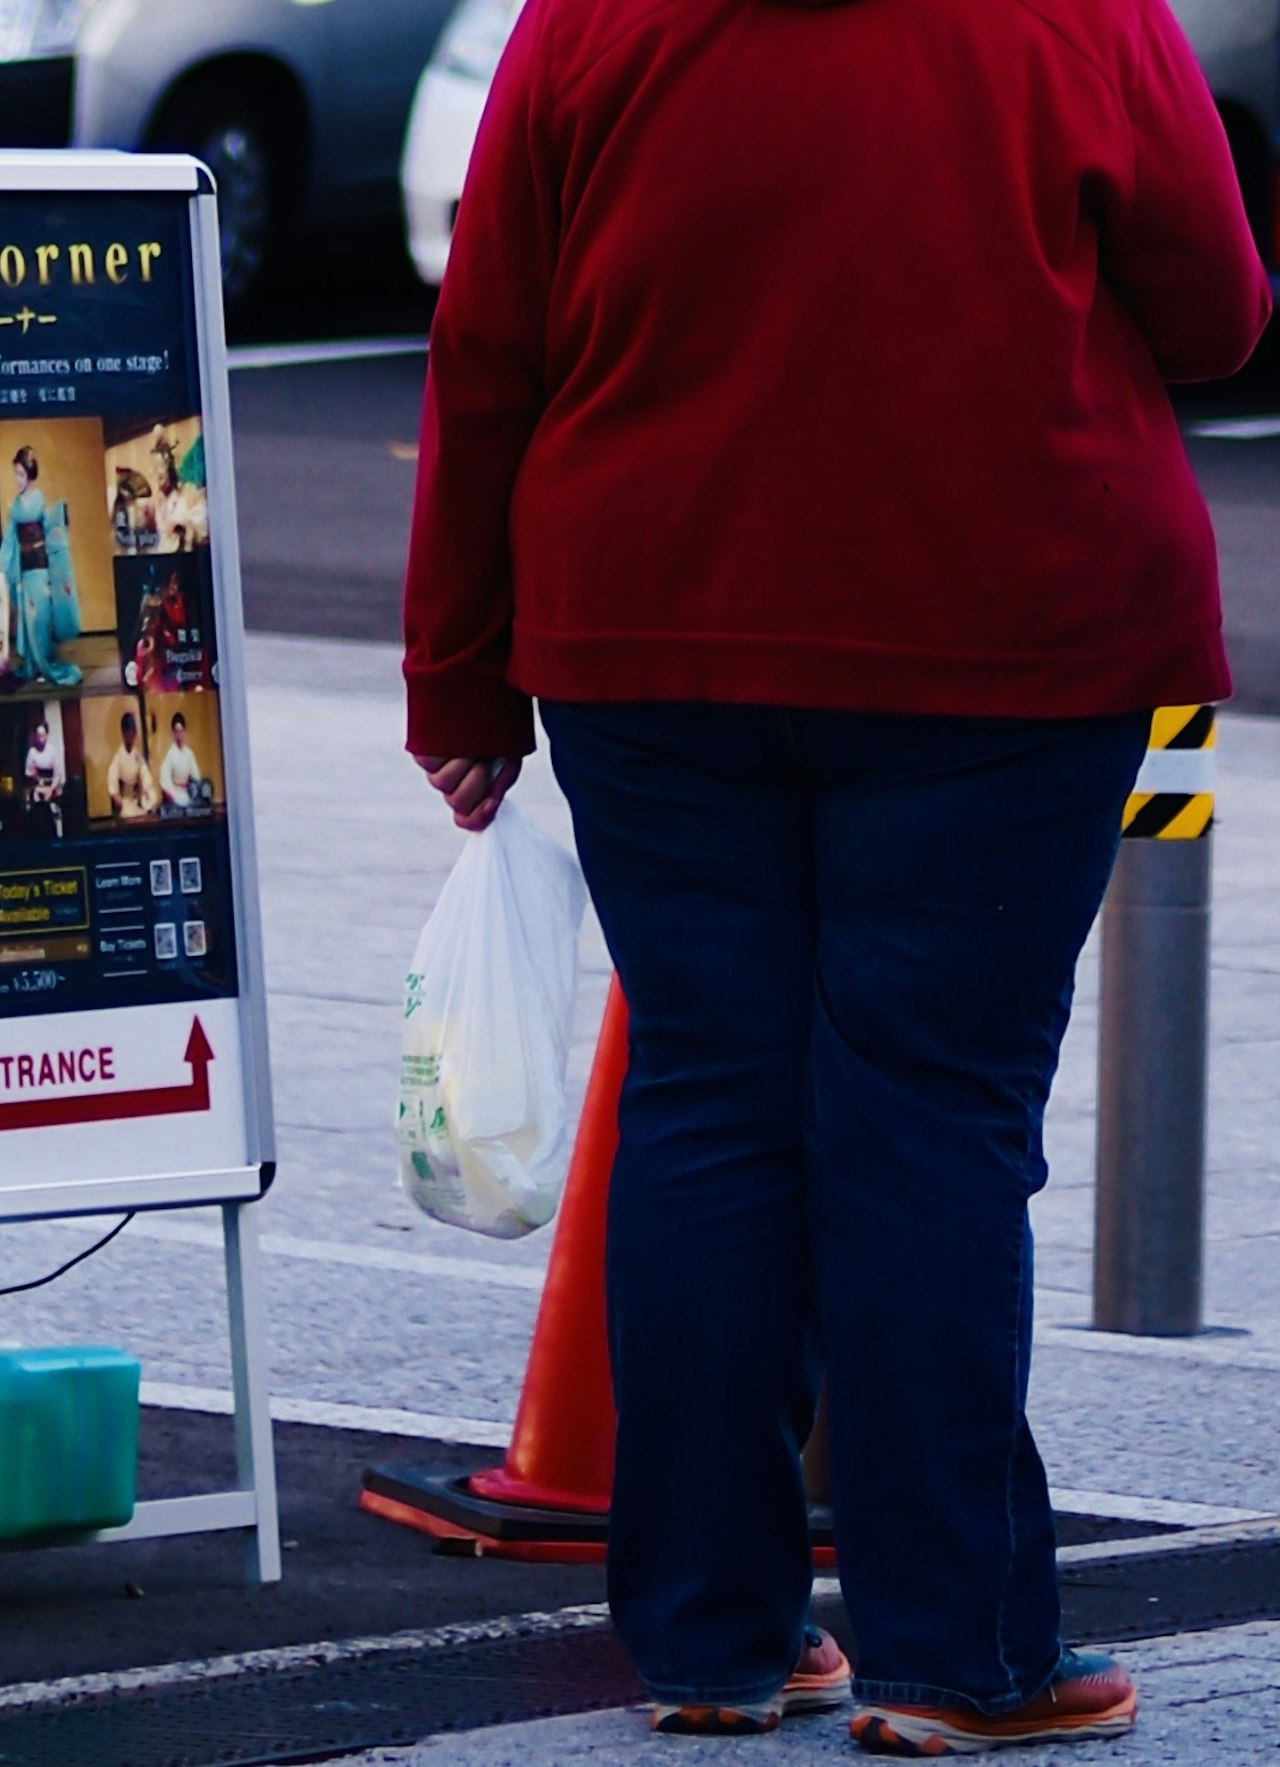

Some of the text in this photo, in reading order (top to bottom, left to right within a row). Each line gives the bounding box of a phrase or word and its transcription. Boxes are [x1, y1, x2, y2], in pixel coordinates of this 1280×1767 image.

[75, 357, 92, 373] on
[96, 356, 121, 372] one
[126, 349, 170, 375] stage!
[43, 880, 78, 896] Ticket
